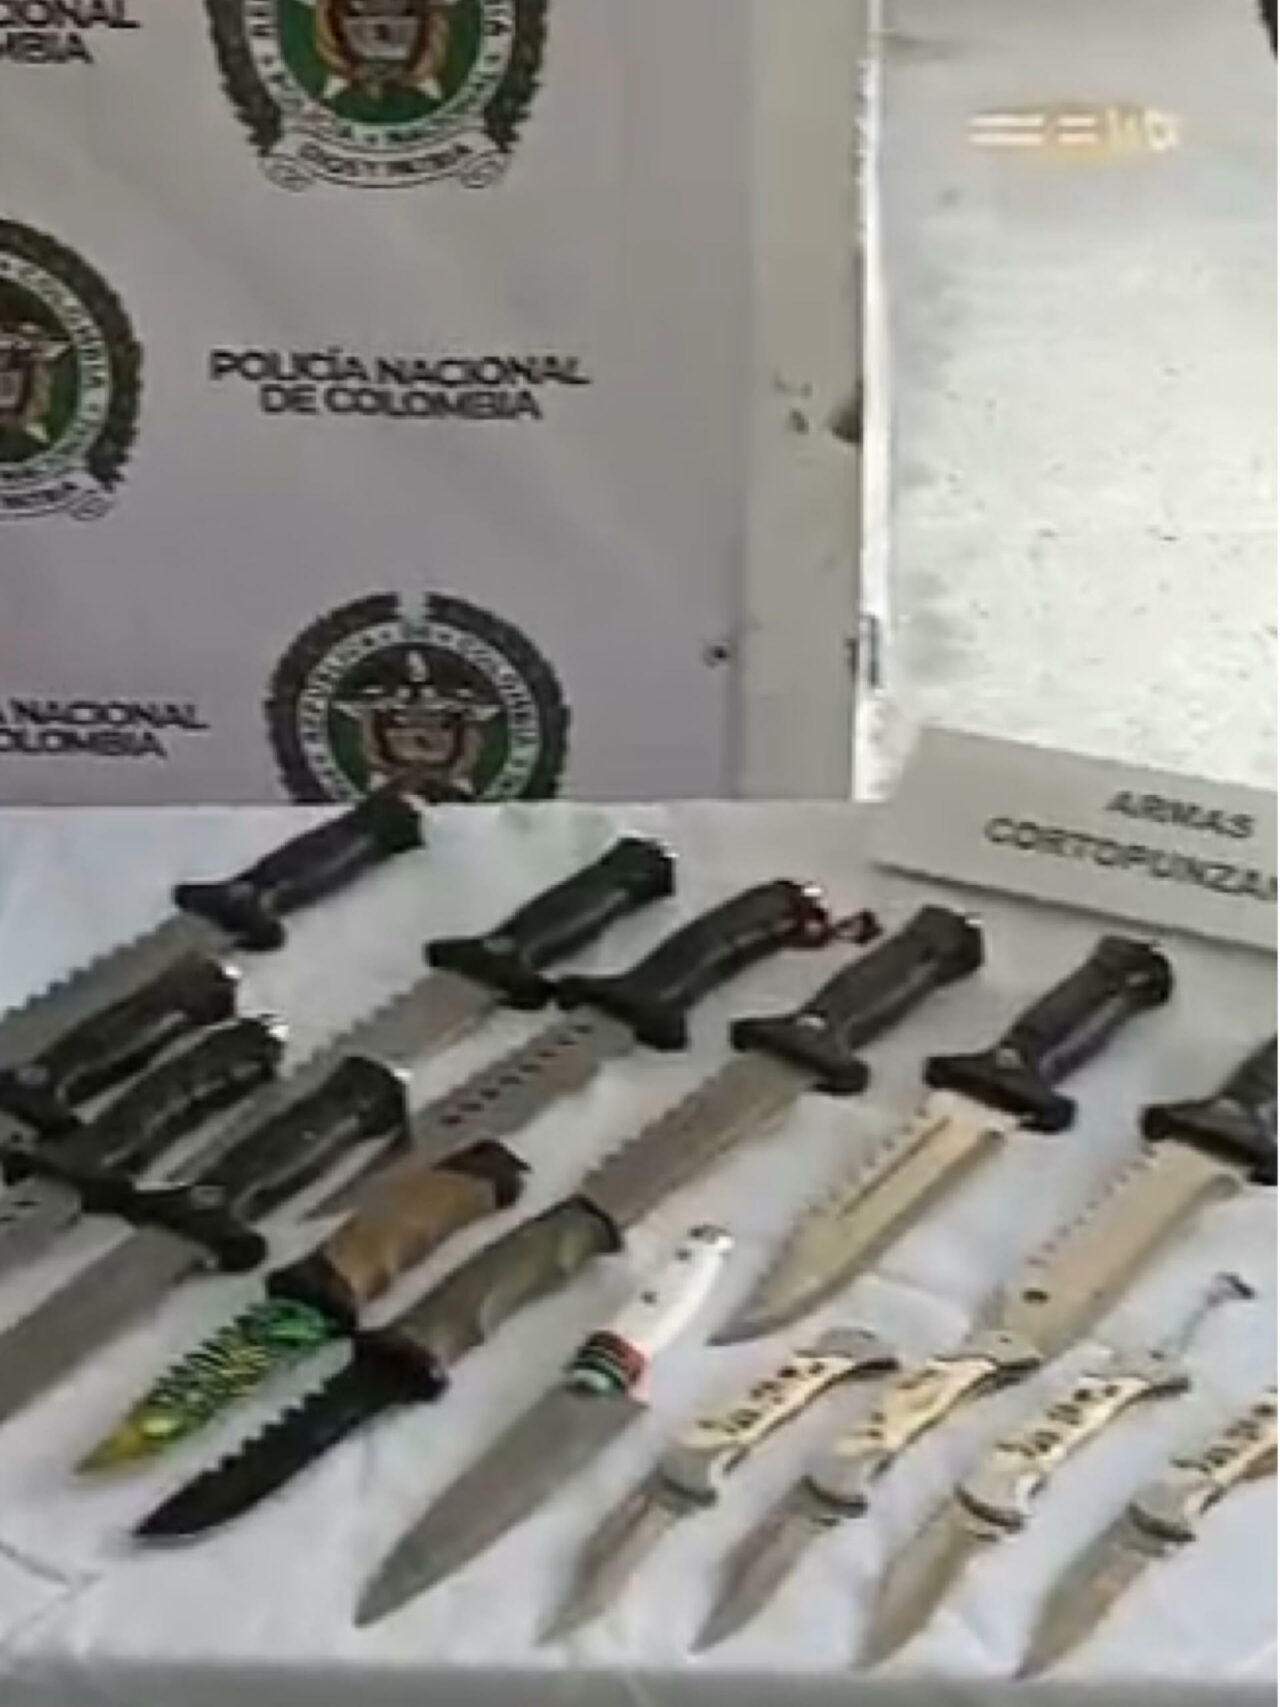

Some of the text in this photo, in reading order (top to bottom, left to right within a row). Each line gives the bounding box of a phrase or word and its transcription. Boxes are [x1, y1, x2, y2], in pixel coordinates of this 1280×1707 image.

[209, 345, 591, 386] POLICÍA NACIONAL
[260, 384, 543, 420] DE COLOMBIA
[10, 697, 211, 729] NACIONAL
[1106, 790, 1256, 838] ARMAS
